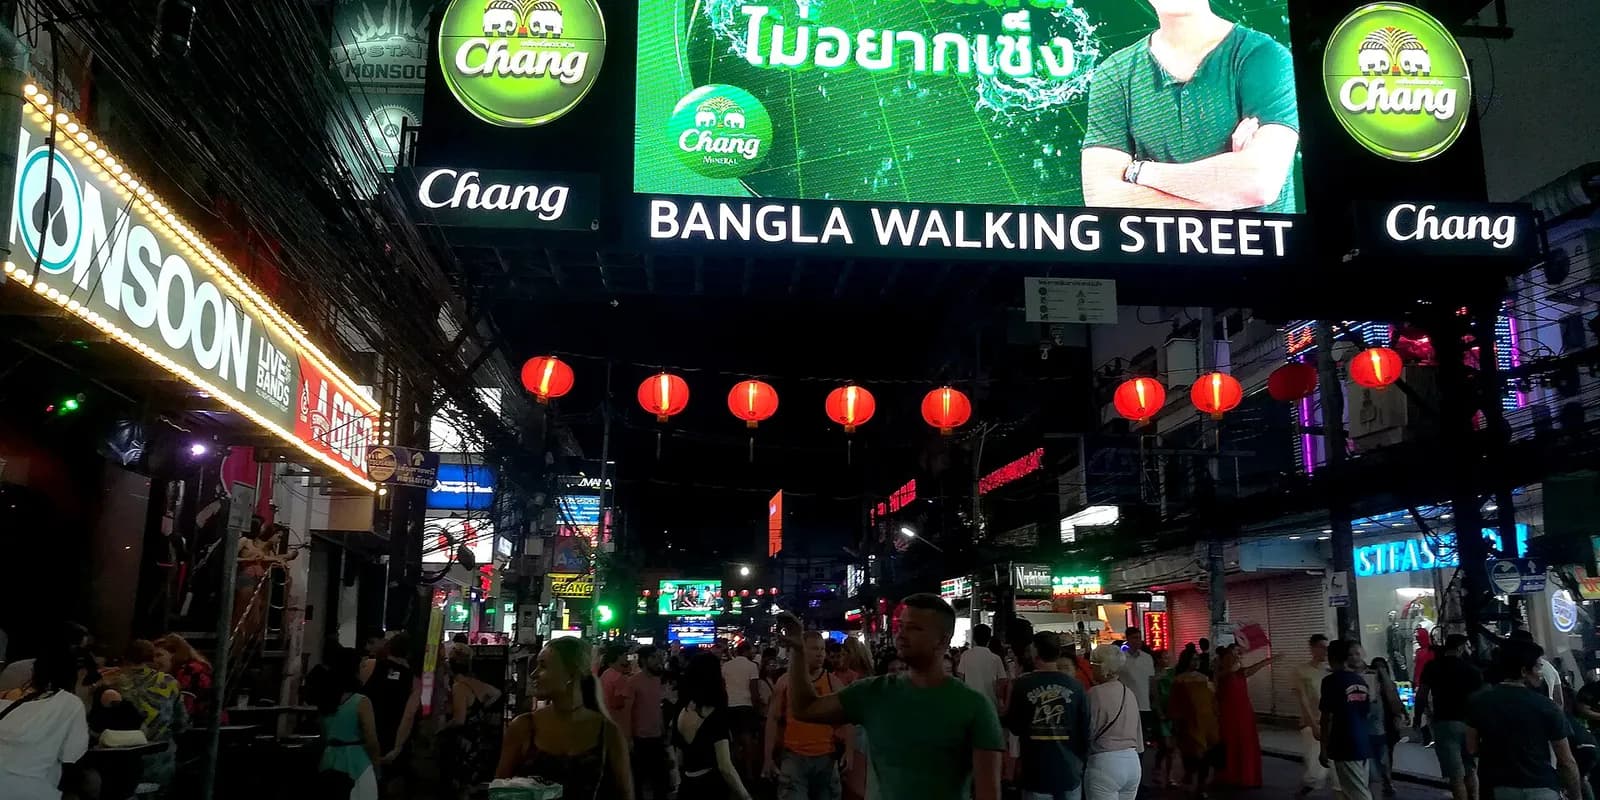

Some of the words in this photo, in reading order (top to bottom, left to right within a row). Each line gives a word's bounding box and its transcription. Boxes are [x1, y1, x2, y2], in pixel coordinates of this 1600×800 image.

[455, 38, 589, 84] Chang
[1340, 78, 1457, 121] Chang
[678, 128, 761, 160] Chang
[418, 168, 570, 222] Chang
[650, 200, 853, 244] BANGLA
[871, 208, 1102, 251] WALKING
[1120, 216, 1293, 257] STREET
[1386, 203, 1516, 249] Chang
[258, 336, 287, 382] LIVE
[256, 364, 290, 407] BANDS
